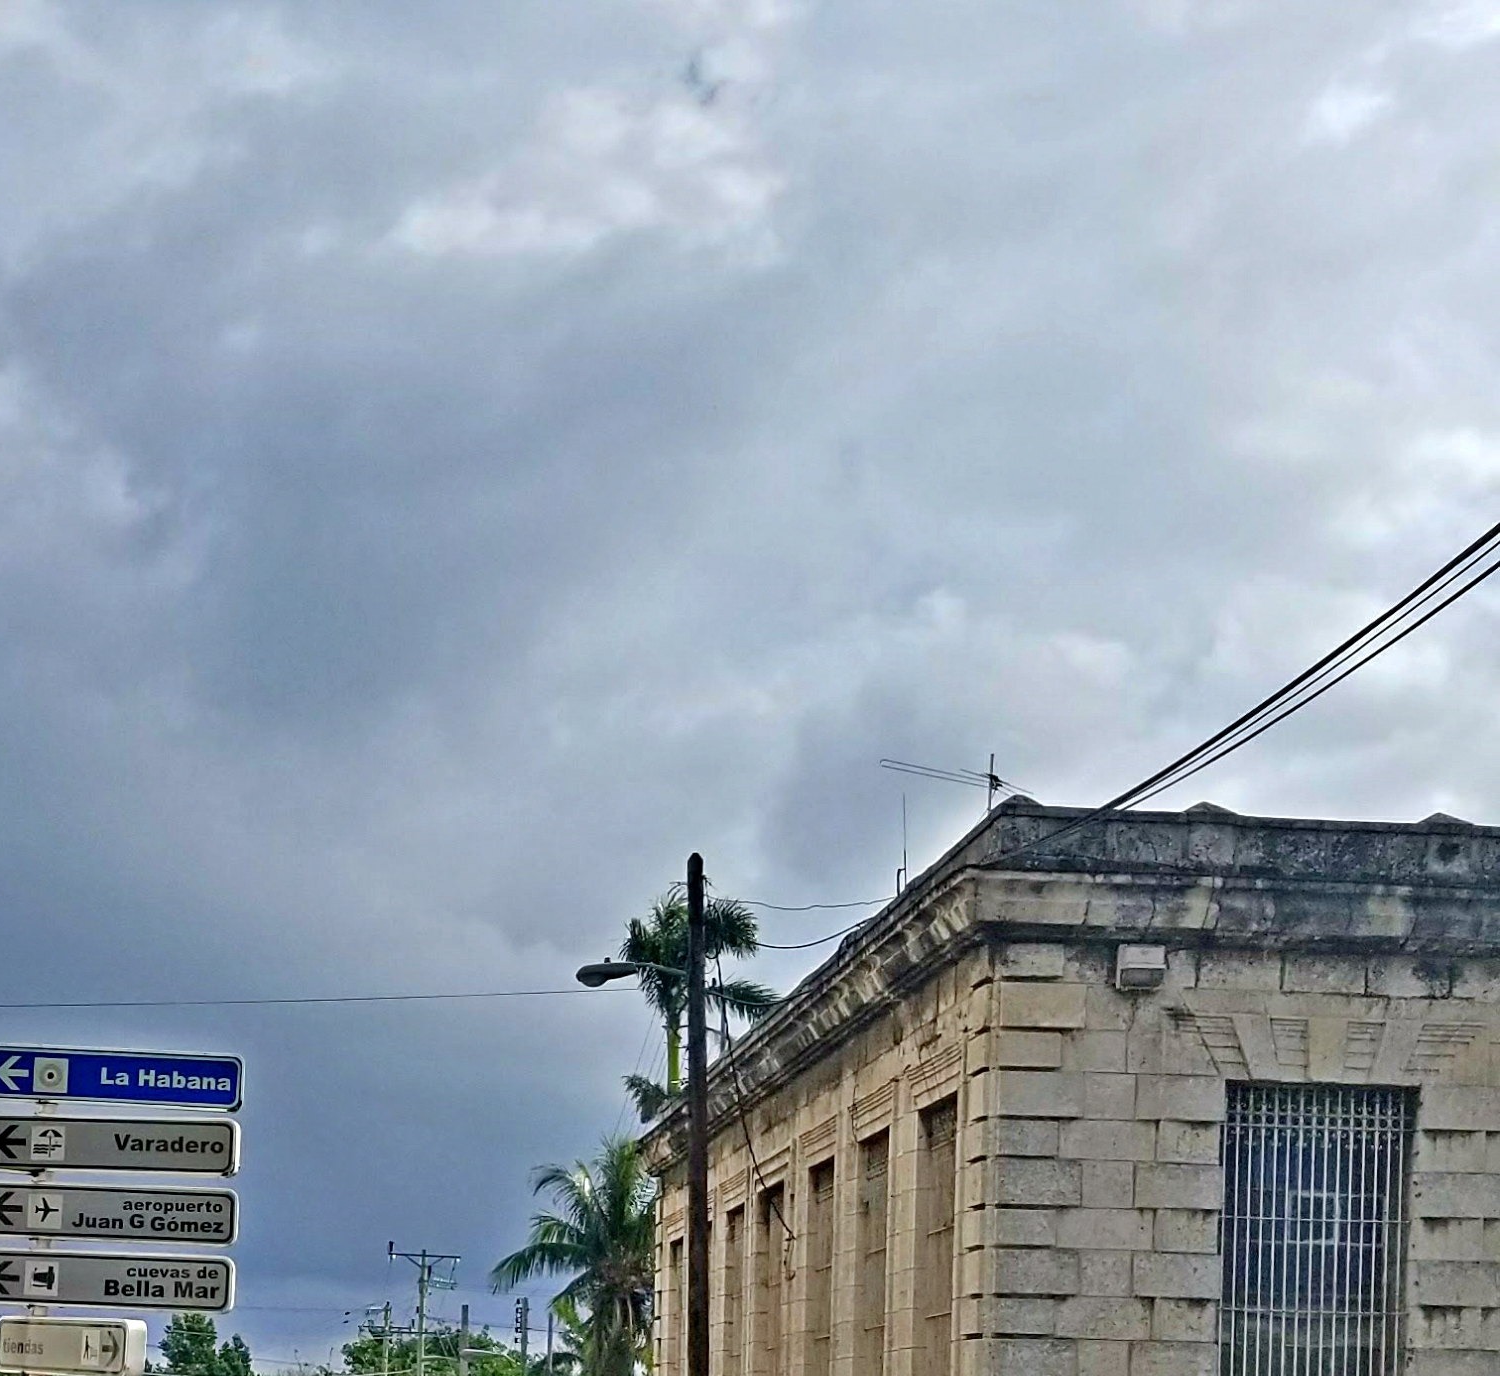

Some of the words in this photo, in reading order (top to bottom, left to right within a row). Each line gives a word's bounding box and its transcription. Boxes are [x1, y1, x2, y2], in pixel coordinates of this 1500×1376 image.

[100, 1066, 130, 1086] La
[138, 1068, 231, 1092] Habana
[113, 1133, 225, 1154] Varadero
[122, 1200, 224, 1214] aeropuerto
[71, 1212, 124, 1230] Juan
[129, 1213, 145, 1229] G
[150, 1215, 224, 1234] Gómez
[126, 1266, 190, 1279] cuevas
[196, 1265, 219, 1280] de
[104, 1278, 165, 1298] Bella
[173, 1280, 220, 1299] Mar
[2, 1338, 44, 1355] tiendas
